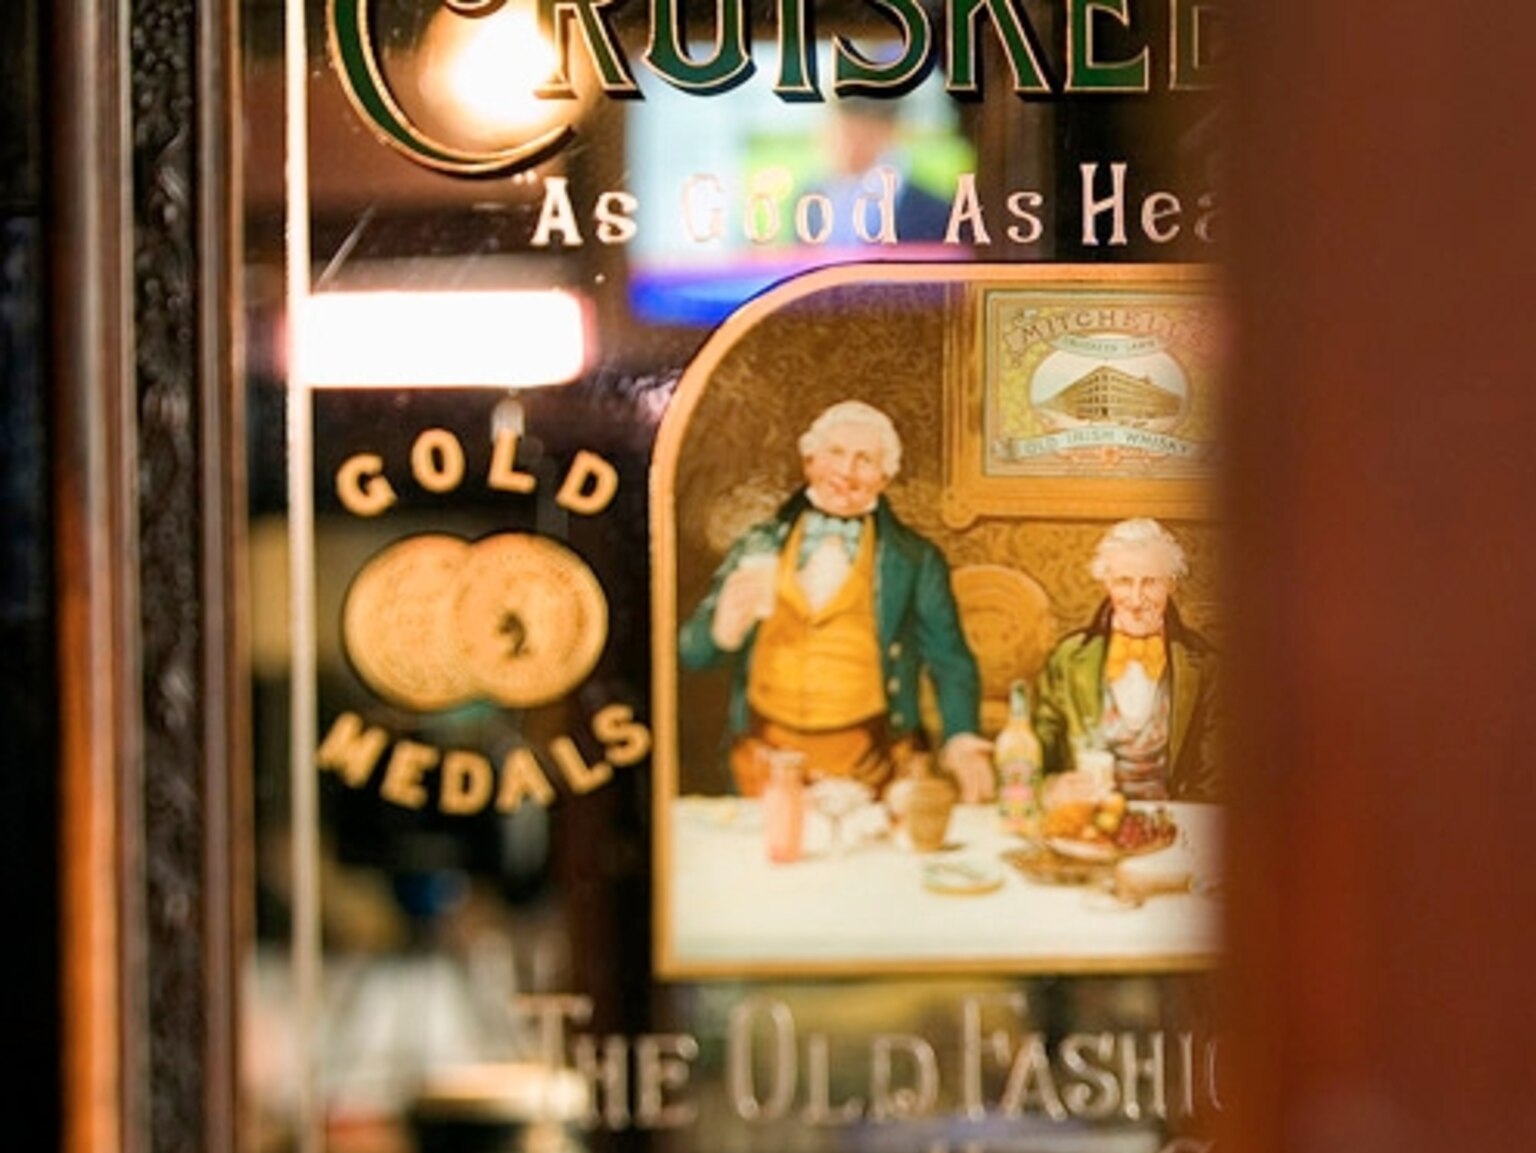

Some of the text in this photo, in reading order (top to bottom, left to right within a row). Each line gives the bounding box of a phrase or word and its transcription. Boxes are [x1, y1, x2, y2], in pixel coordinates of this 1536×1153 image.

[680, 167, 898, 247] Good
[945, 173, 1044, 247] As
[336, 427, 619, 517] GOLD
[315, 703, 652, 816] MEDALS
[513, 993, 698, 1129] THE
[728, 1000, 938, 1126] OLD
